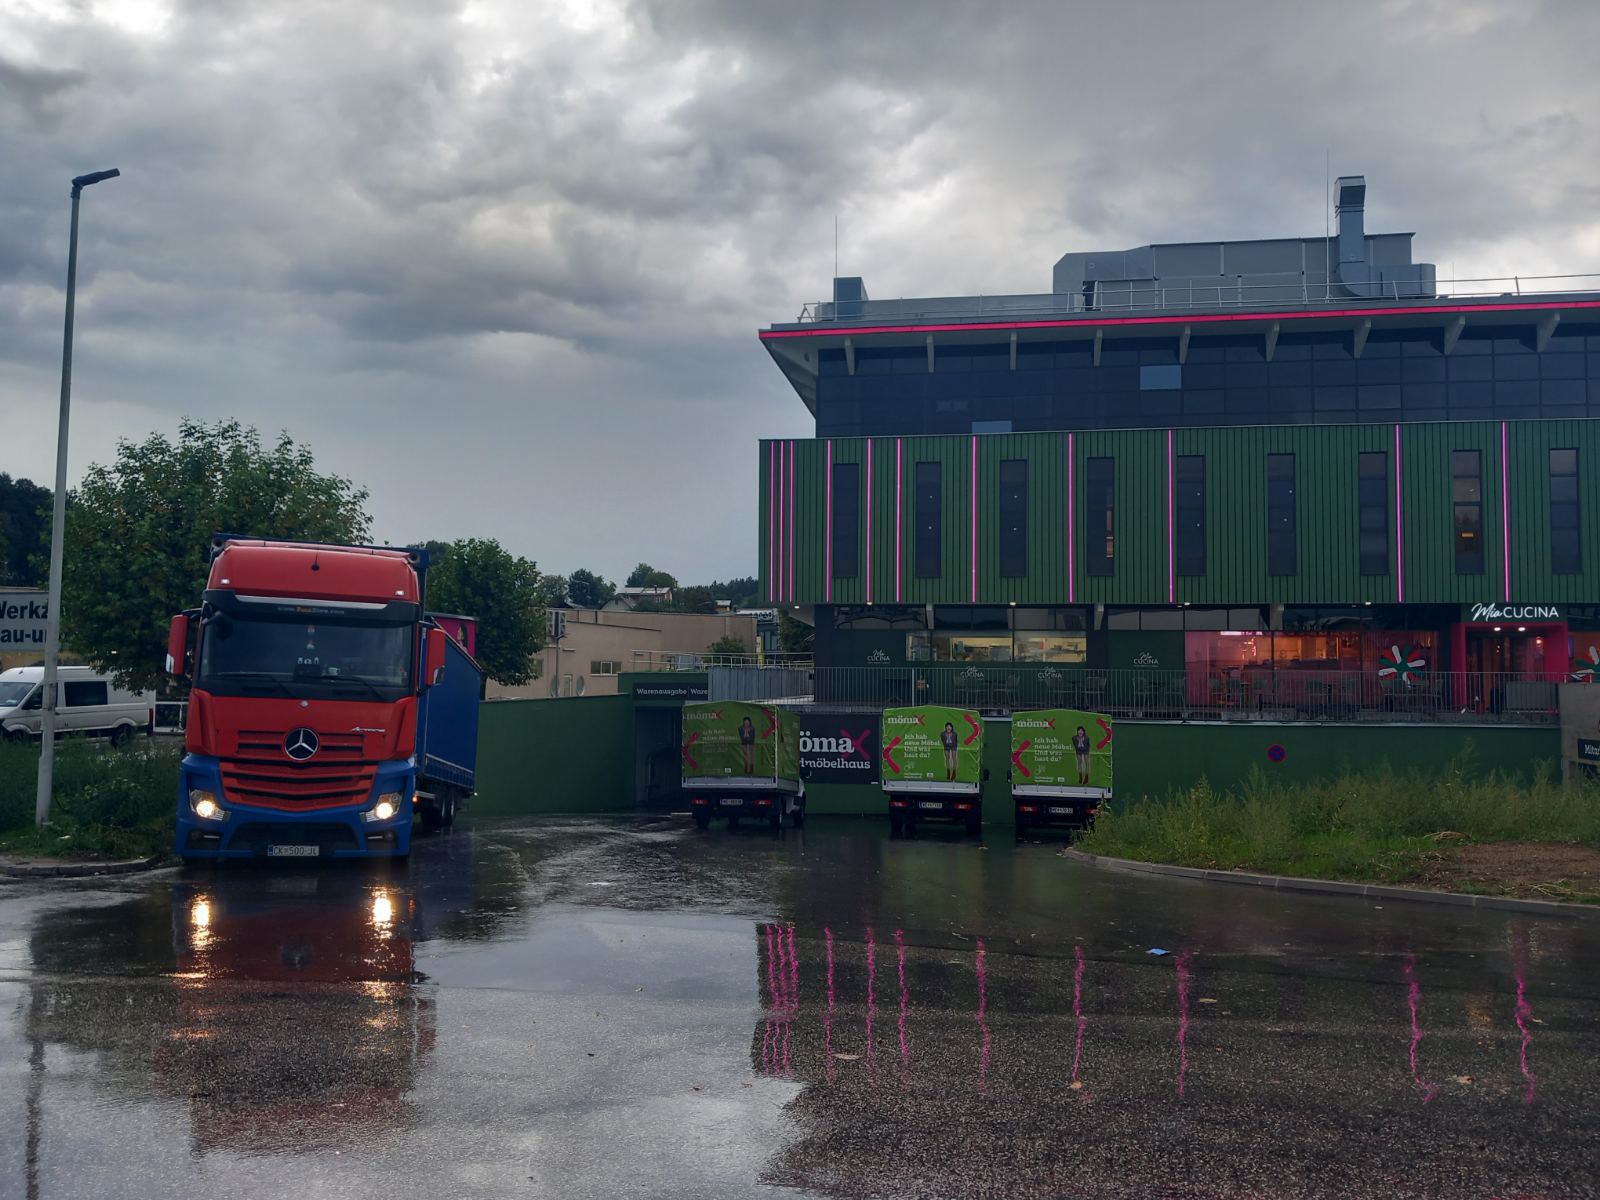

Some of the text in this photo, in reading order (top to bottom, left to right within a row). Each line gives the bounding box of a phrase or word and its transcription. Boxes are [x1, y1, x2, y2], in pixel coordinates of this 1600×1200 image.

[1471, 602, 1559, 621] Mia CUCINA
[636, 688, 687, 697] Warenausgabe
